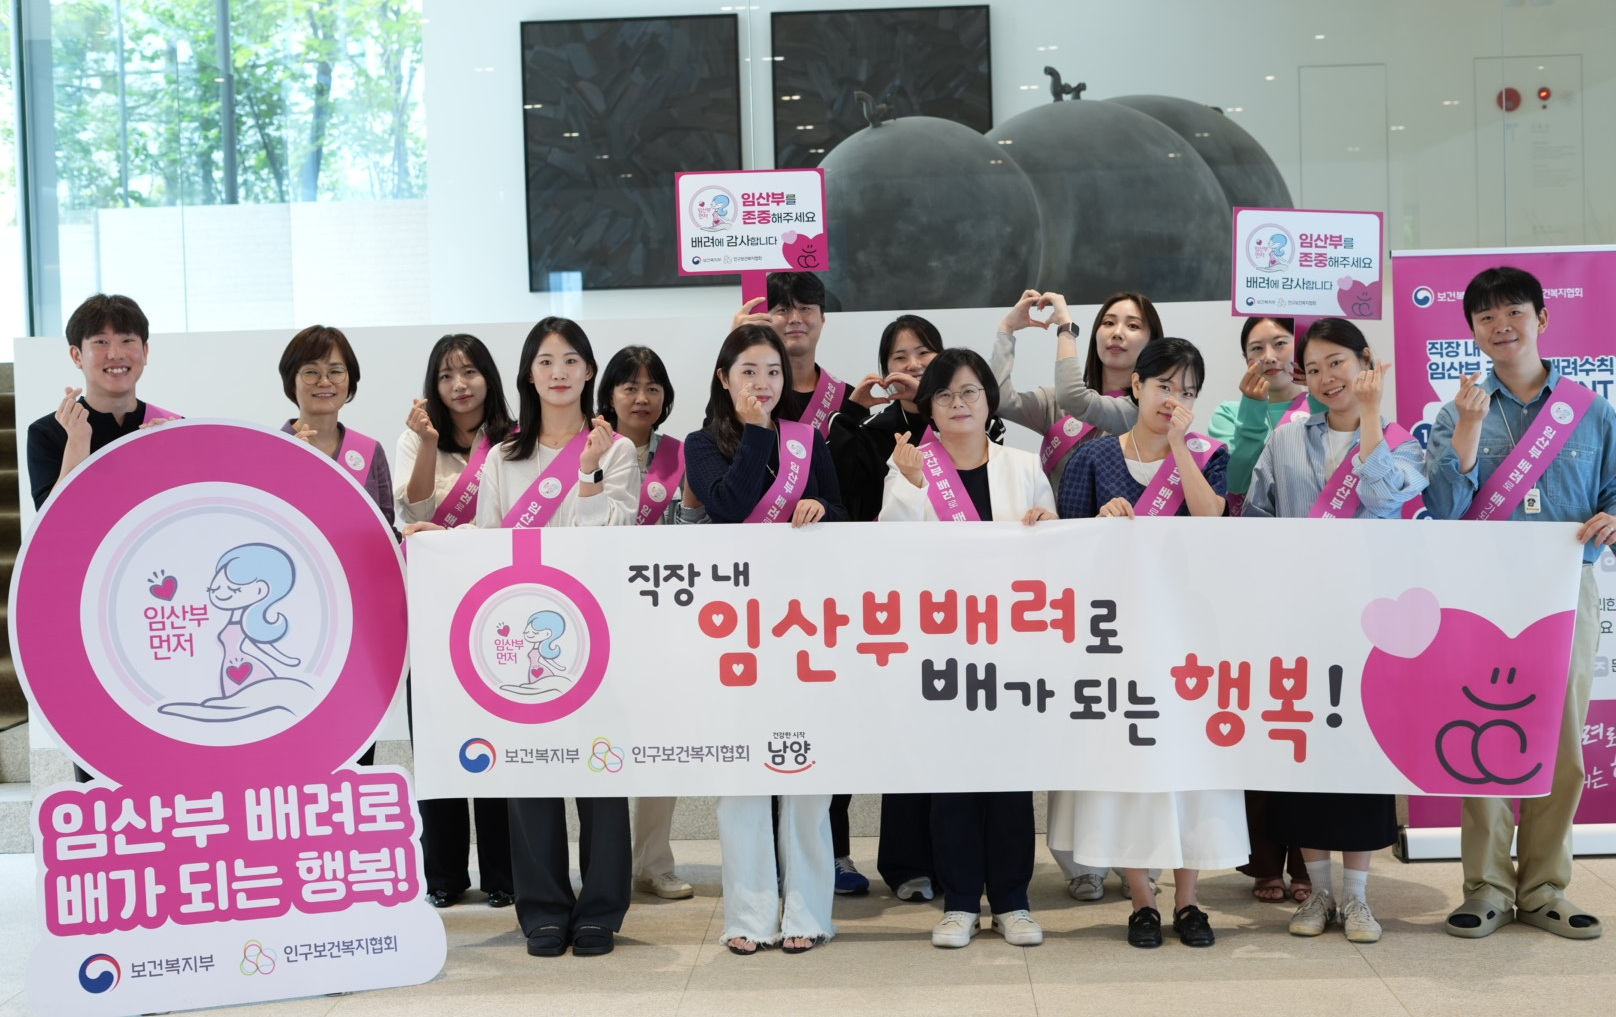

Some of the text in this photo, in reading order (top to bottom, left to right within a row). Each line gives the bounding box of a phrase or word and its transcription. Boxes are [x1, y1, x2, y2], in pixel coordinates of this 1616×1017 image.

[741, 191, 797, 207] 임산부를
[741, 209, 816, 225] 존중해주세요
[691, 234, 778, 248] 배려에 감사합니다
[1299, 233, 1354, 250] 임산부를
[1298, 252, 1373, 269] 존중해주세요
[1246, 276, 1333, 291] 배려에 감사합니다
[1428, 340, 1480, 358] 직장 내
[1528, 425, 1557, 459] 임산부
[1330, 474, 1358, 510] 임산부
[627, 561, 750, 608] 직장 내
[143, 603, 210, 630] 임산부
[149, 633, 194, 661] 먼저
[494, 638, 525, 651] 임산부
[496, 652, 518, 665] 먼저
[921, 652, 1344, 764] 배가 되는 행복!
[504, 748, 580, 764] 보건복지부
[631, 744, 750, 764] 인구보건복지협회
[766, 739, 812, 766] 남양
[51, 780, 406, 862] 임산부 배려로
[55, 846, 408, 926] 배가 되는 행복!
[283, 935, 398, 963] 인구보건복지협회
[130, 954, 215, 979] 보건복지부
